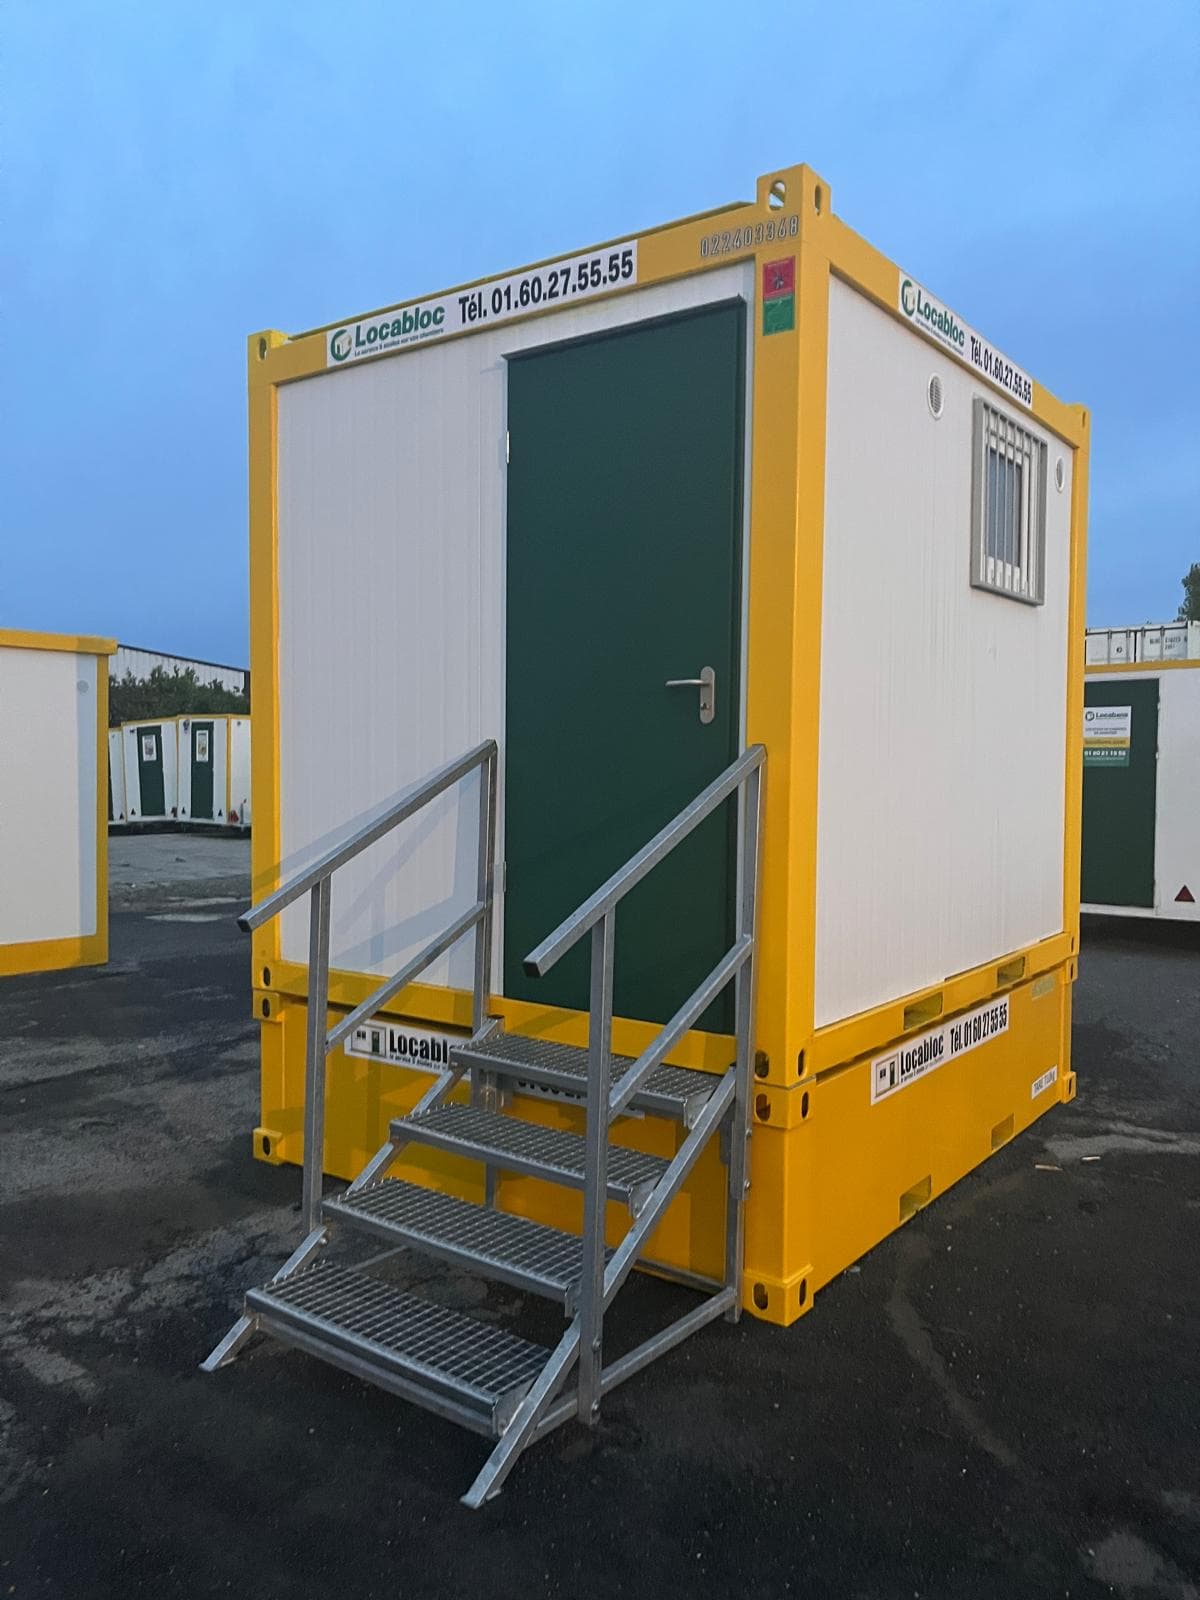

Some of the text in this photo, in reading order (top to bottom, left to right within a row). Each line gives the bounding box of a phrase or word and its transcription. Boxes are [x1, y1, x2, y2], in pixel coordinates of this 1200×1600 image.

[354, 305, 445, 348] Locabloc
[458, 291, 487, 324] Tél.
[491, 250, 633, 314] 01.60.27.55.55
[917, 289, 965, 348] Locabloc
[970, 335, 983, 368] Tél.
[984, 348, 1031, 404] 01.60.27.55.55
[390, 1029, 456, 1064] Locabl
[901, 1034, 944, 1076] Locabloc
[950, 1023, 963, 1055] Tél.
[964, 1019, 972, 1048] 01
[973, 1015, 982, 1043] 60
[982, 1011, 990, 1038] 27
[991, 1006, 999, 1034] 55
[1000, 1002, 1008, 1029] 55
